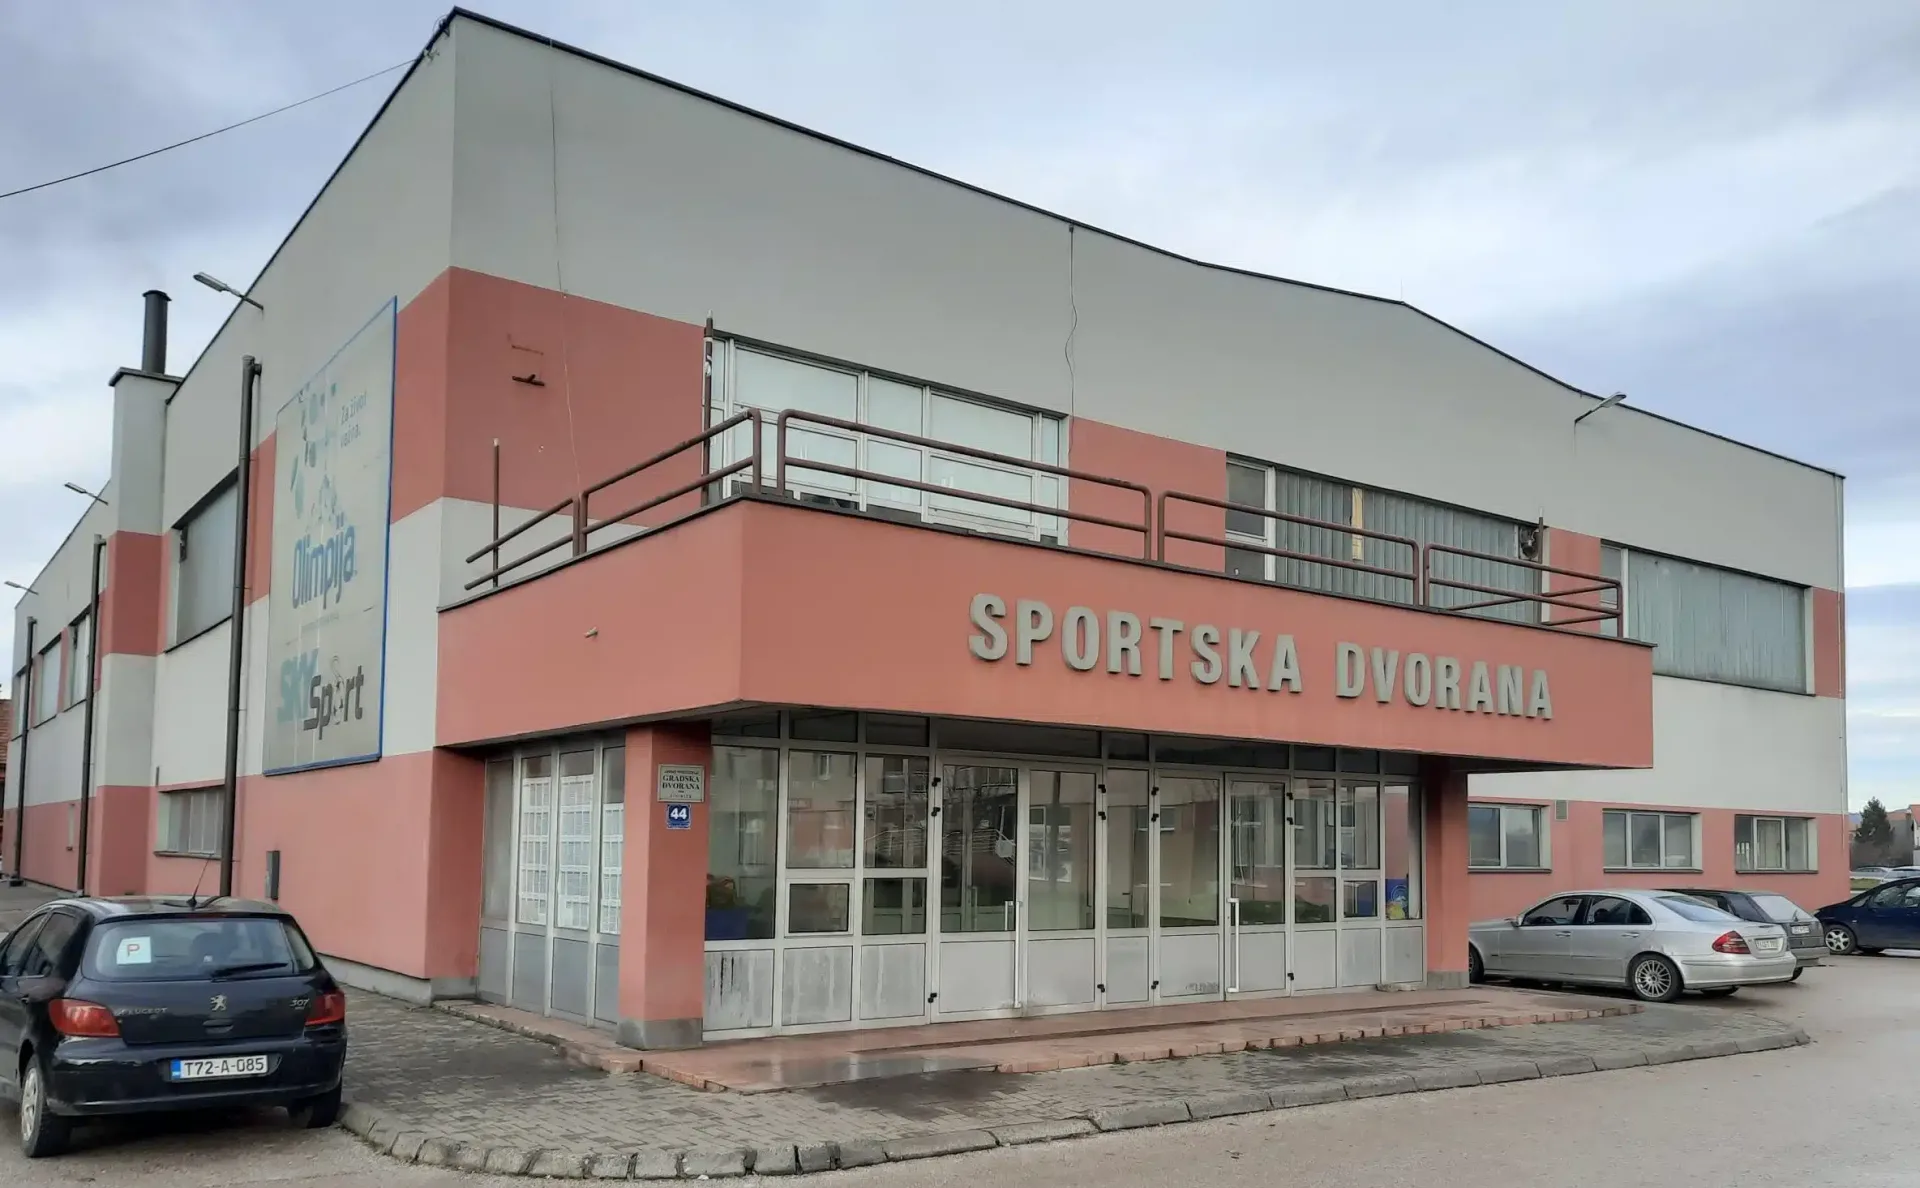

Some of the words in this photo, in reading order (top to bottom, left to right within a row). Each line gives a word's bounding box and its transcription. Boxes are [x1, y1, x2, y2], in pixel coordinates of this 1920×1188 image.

[292, 511, 356, 610] Olimpija
[968, 592, 1302, 693] SPORTSKA
[1335, 641, 1554, 720] DVORANA
[670, 807, 687, 820] 44
[126, 943, 140, 957] P
[289, 998, 310, 1007] 307
[184, 1057, 265, 1076] T72-A-085
